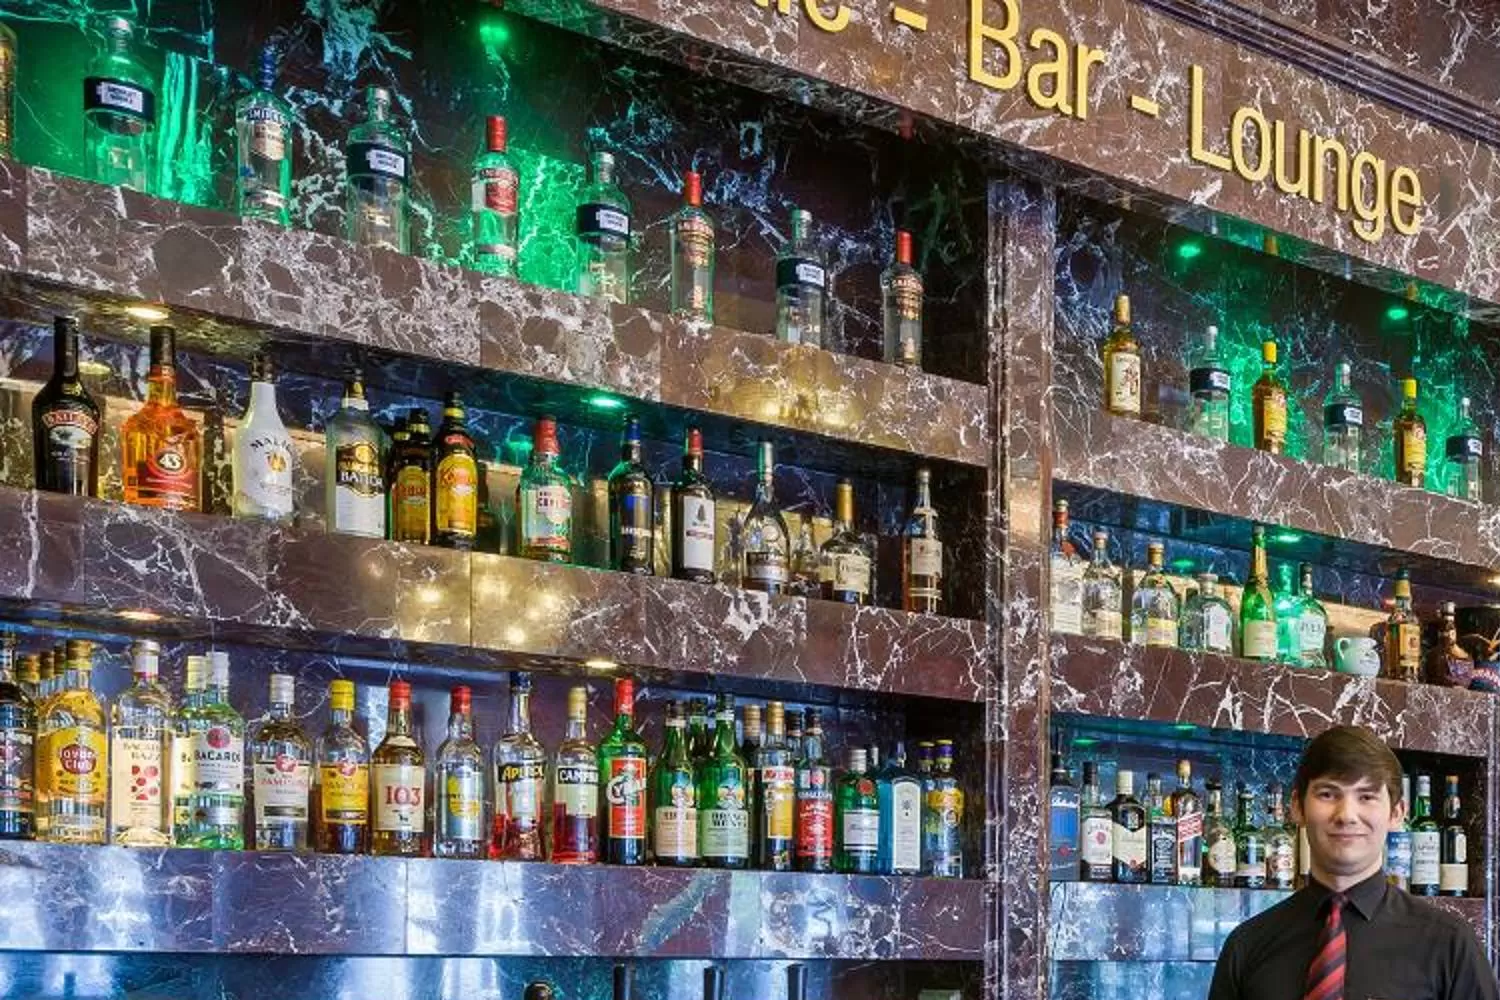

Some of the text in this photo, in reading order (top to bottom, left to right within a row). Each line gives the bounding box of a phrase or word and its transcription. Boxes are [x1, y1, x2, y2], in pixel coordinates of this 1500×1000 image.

[968, 0, 1105, 120] Bar
[1190, 64, 1422, 243] Lounge
[384, 785, 421, 806] 103
